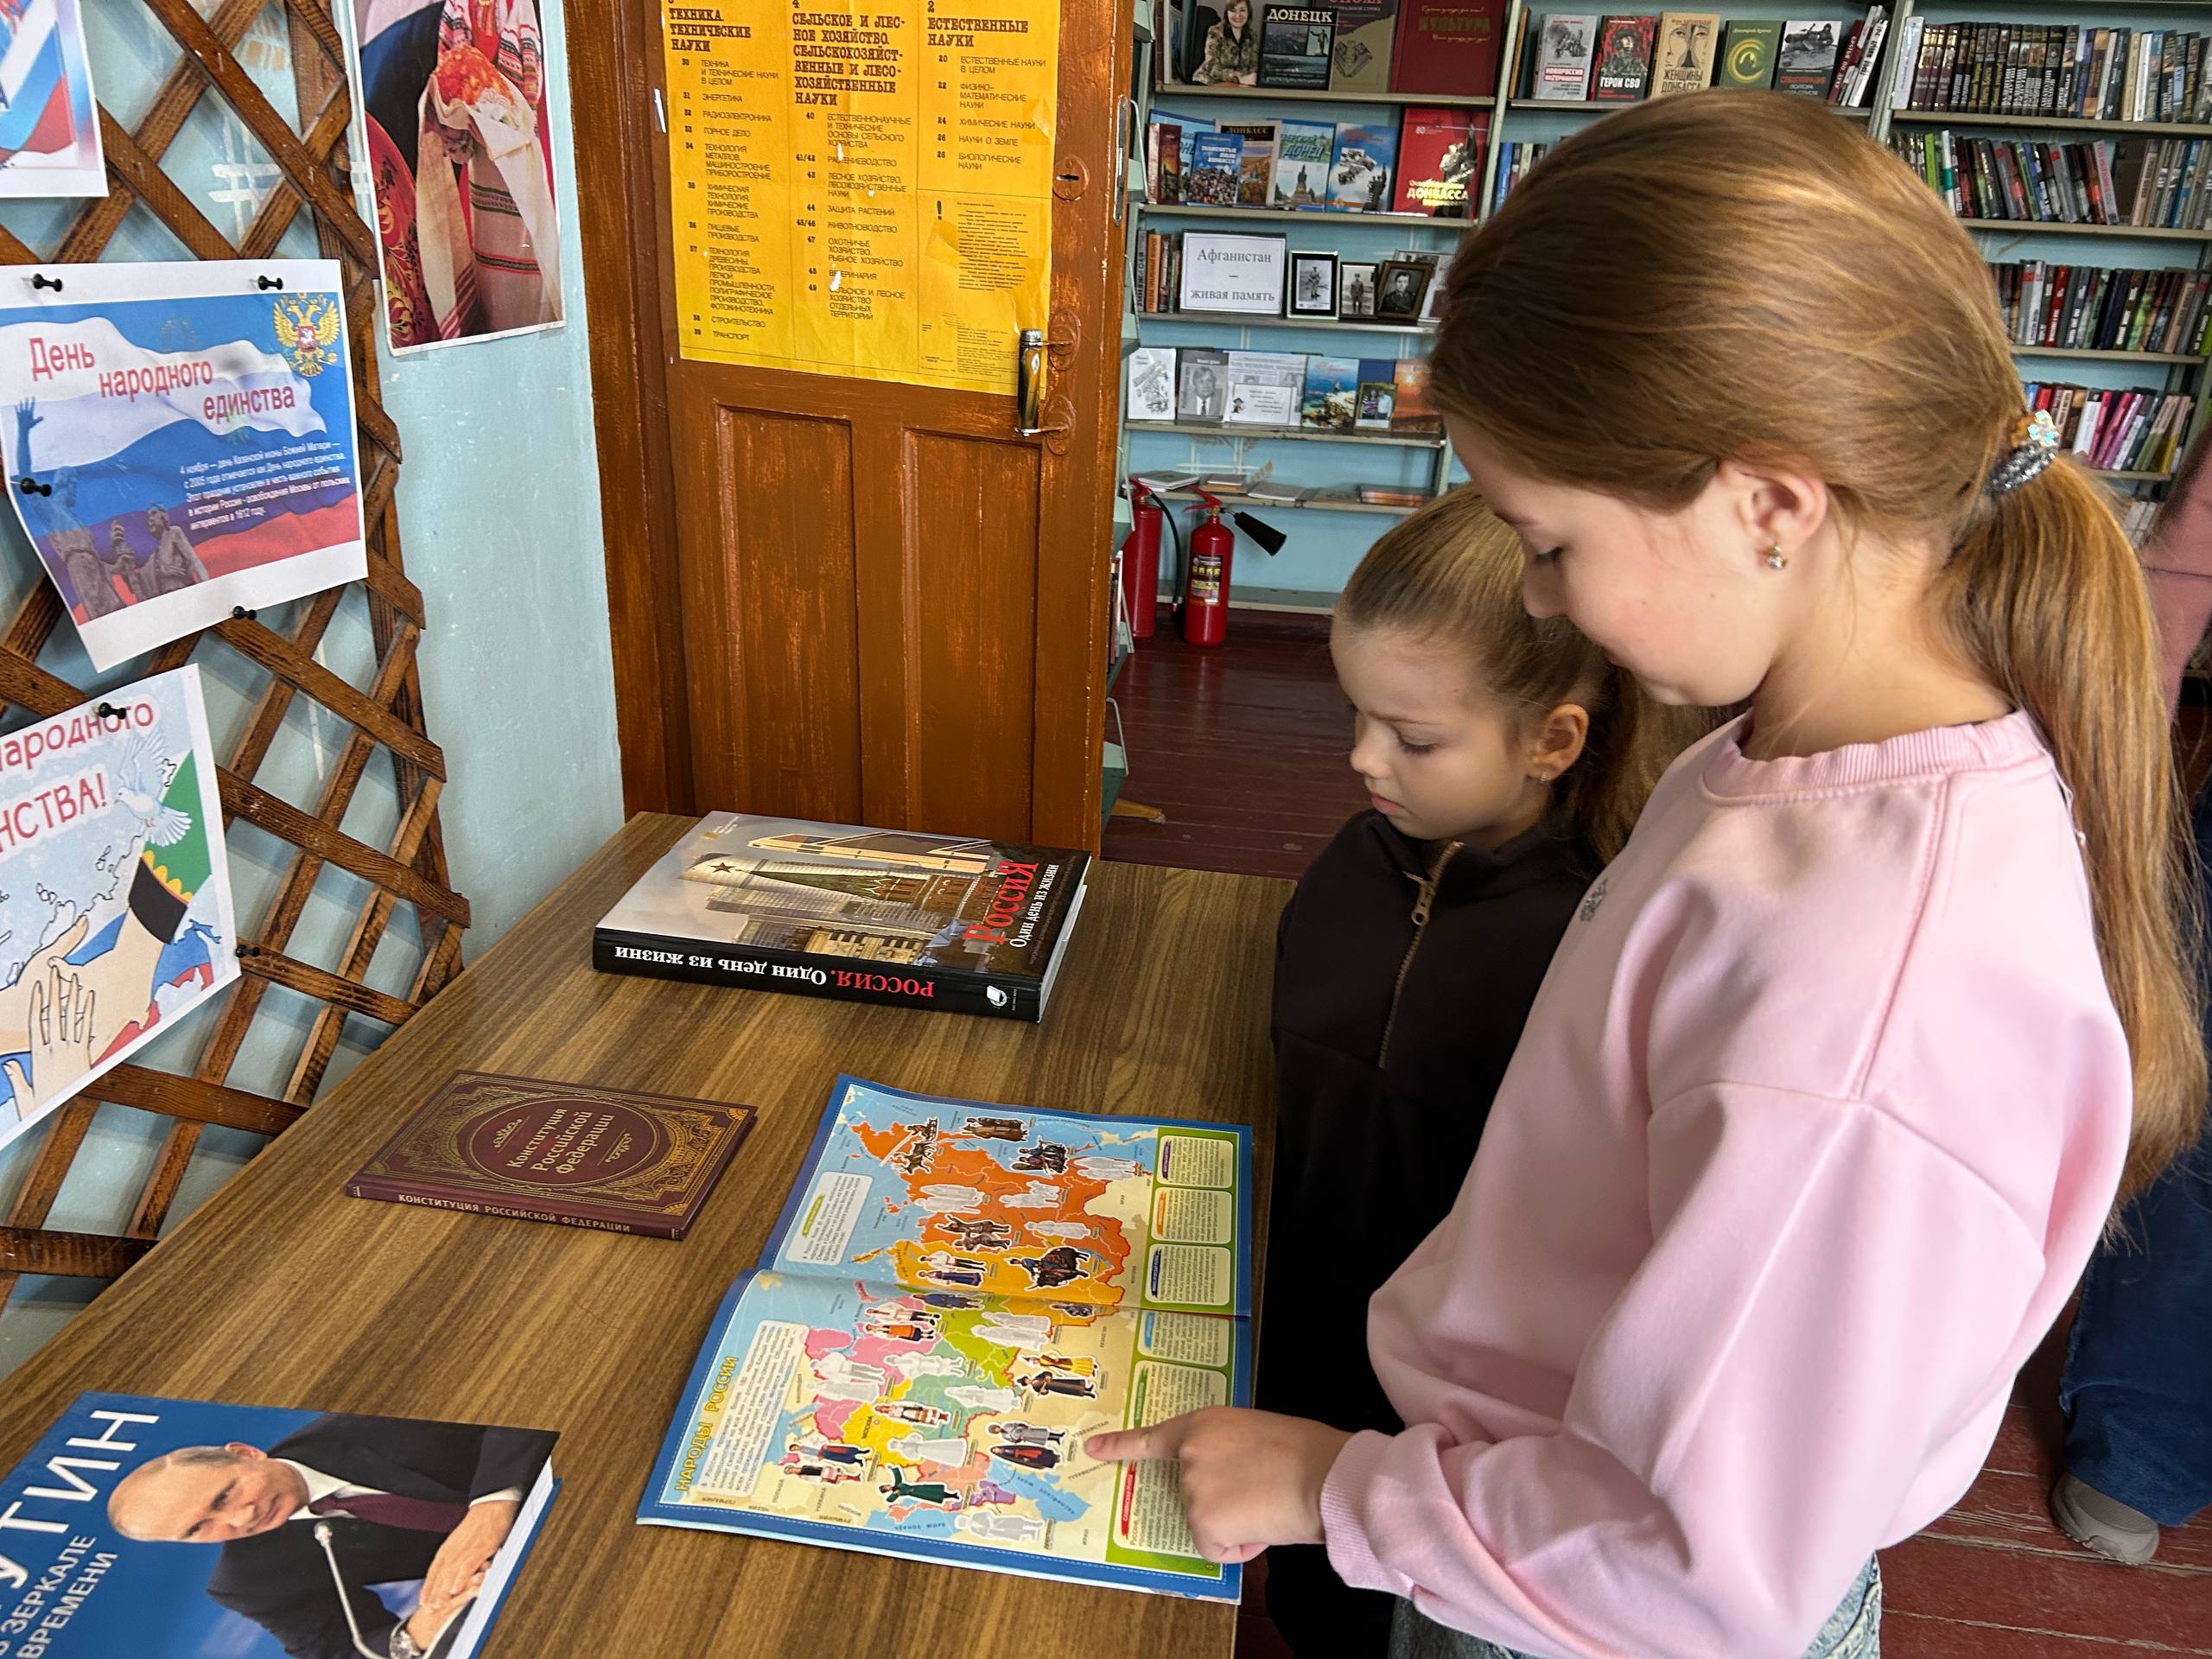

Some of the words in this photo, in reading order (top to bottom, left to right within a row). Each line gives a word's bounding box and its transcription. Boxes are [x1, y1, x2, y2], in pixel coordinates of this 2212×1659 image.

[927, 0, 935, 13] 2
[670, 8, 724, 21] ТЕХНИКА.
[792, 13, 853, 27] СЕЛЬСКОЕ
[860, 15, 868, 28] И
[874, 16, 906, 29] ЛЕС-
[1266, 8, 1332, 23] ДОНЕЦК
[670, 23, 751, 38] ТЕХНИЧЕСКИЕ
[927, 17, 1028, 33] ЕСТЕСТВЕННЫЕ
[793, 29, 816, 41] НОЕ
[927, 34, 974, 47] НАУКИ
[671, 39, 710, 52] НАУКИ
[793, 45, 903, 61] СЕЛЬСКОХОЗЯЙСТ-
[794, 60, 844, 74] ВЕННЫЕ
[849, 64, 858, 75] И
[863, 65, 901, 77] ЛЕСО-
[961, 56, 1020, 66] ЕСТЕСТВЕННЫЕ
[1600, 76, 1623, 88] ГЕРОИ
[1624, 78, 1640, 89] СВО
[1663, 69, 1703, 81] ЖЕНЩИНЫ
[794, 75, 895, 93] ХОЗЯЙСТВЕННЫЕ
[795, 92, 837, 105] НАУКИ
[828, 130, 858, 139] ОСНОВЫ
[861, 132, 904, 142] СЕЛЬСКОГО
[995, 137, 1018, 146] ЗЕМЛЕ
[828, 156, 897, 167] РАСЕНИЕВОДСТВО
[1407, 188, 1469, 200] ДОНБАССА
[828, 206, 855, 214] ЗАЩИТА
[858, 207, 895, 216] РАСТЕНИЙ
[828, 222, 897, 233] ЖИВОТНОВОДСТВО
[1197, 249, 1272, 265] Афганистан
[830, 270, 877, 280] ВЕЕРИНАРИЯ
[830, 287, 866, 296] ЛЬСКОЕ
[1190, 290, 1230, 302] живая
[1231, 290, 1275, 304] память
[711, 316, 766, 327] СТРОИТЕЛЬСТВО
[713, 331, 750, 340] ТРАНСПОРТ
[29, 338, 95, 381] День
[99, 359, 213, 403] народного
[203, 386, 296, 423] единства
[0, 703, 153, 771] ародного
[614, 947, 683, 964] жизни
[689, 955, 713, 969] из
[718, 959, 768, 975] день
[772, 965, 827, 986] Один
[506, 1109, 567, 1167] Конституция
[531, 1111, 593, 1171] Российской
[556, 1115, 614, 1173] Федерации
[398, 1193, 480, 1213] КОНСТИТУЦИЯ
[485, 1205, 557, 1224] РОССИЙСКОЙ
[562, 1216, 631, 1233] ФЕДЕРАЦИИ
[675, 1420, 712, 1492] НАРОДЫ
[704, 1355, 739, 1413] РОССИИ
[1, 1535, 97, 1635] ЗЕРКАЛЕ
[16, 1552, 119, 1659] ВРЕМЕНИ
